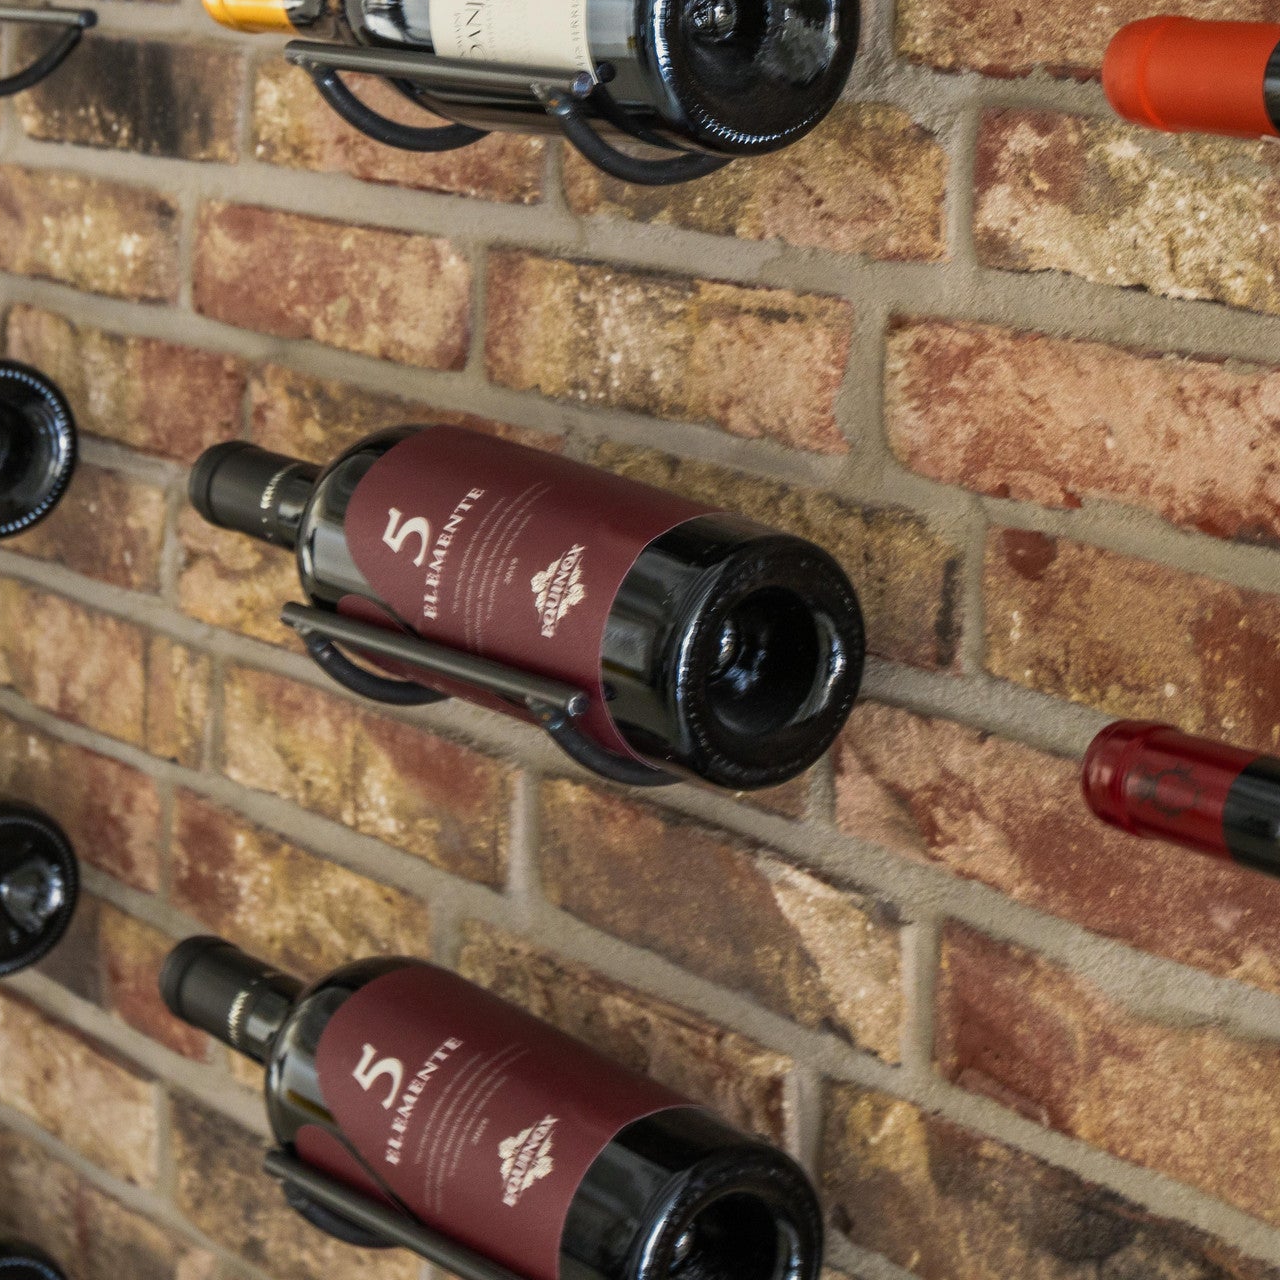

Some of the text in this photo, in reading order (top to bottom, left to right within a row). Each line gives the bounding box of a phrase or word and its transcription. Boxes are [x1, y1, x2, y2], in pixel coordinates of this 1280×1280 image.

[382, 506, 431, 568] 5
[423, 487, 486, 621] ELEMENTE
[541, 543, 587, 639] EQUINOX
[352, 1043, 403, 1110] 5
[385, 1036, 464, 1166] ELEMENTE
[502, 1114, 560, 1208] EQUINOX
